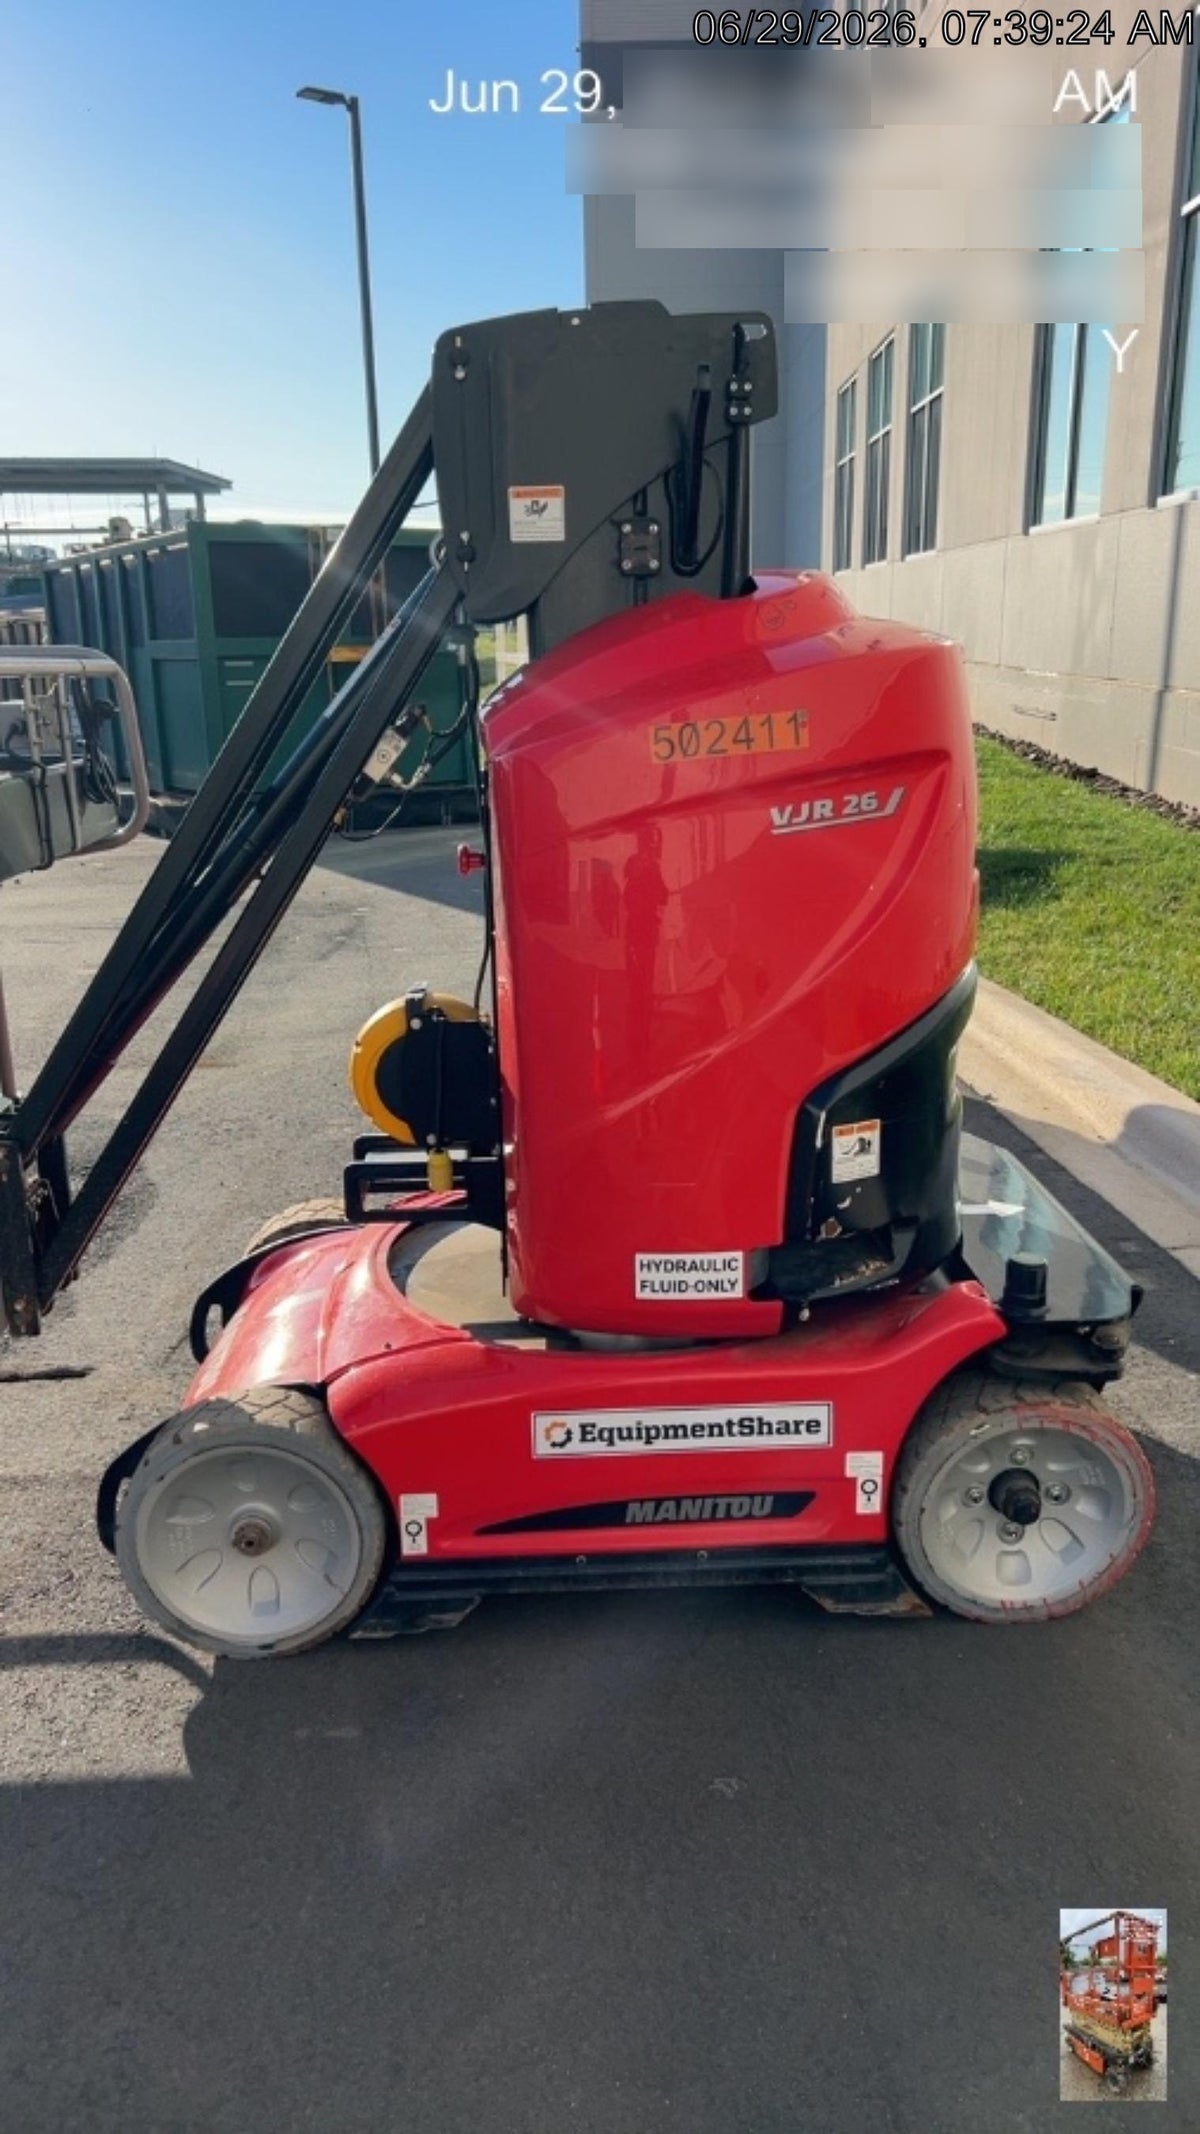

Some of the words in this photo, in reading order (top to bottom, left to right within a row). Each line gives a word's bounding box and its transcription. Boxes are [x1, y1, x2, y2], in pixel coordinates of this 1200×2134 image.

[653, 711, 801, 761] 502411
[769, 798, 834, 827] VJR
[842, 791, 878, 815] 26
[639, 1256, 739, 1274] HYDRAULIC
[578, 1416, 822, 1447] EquipmentShare
[625, 1495, 774, 1524] MANITOU
